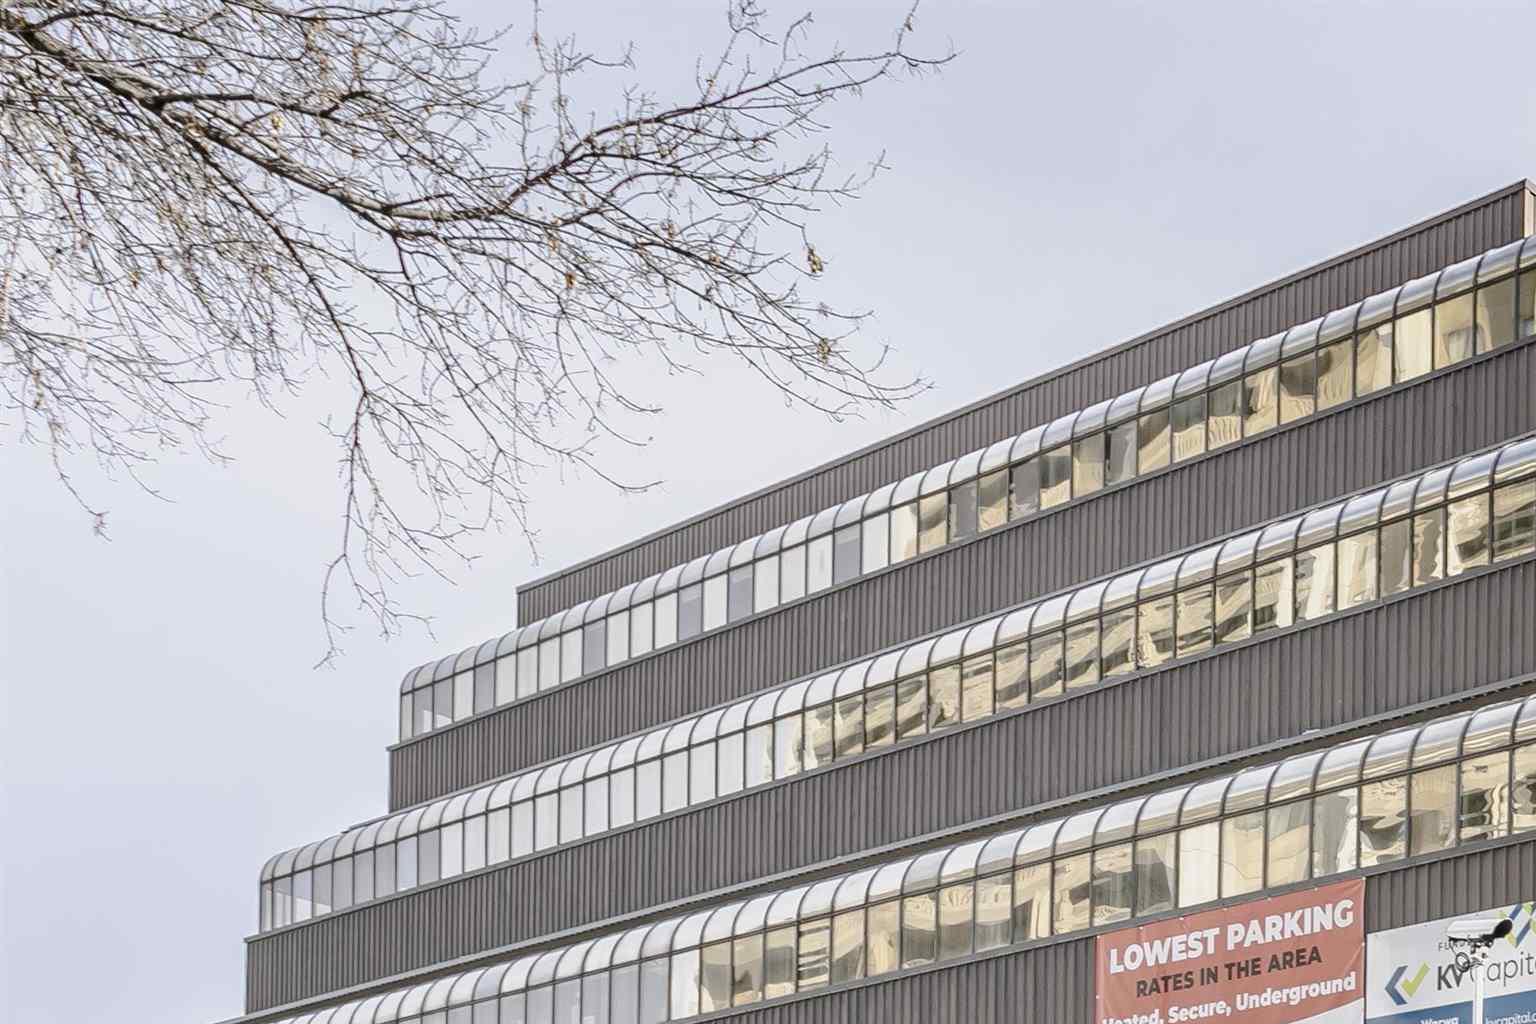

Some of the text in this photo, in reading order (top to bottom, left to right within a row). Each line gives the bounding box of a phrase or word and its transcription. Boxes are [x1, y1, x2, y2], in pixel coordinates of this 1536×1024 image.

[1109, 899, 1354, 974] LOWEST PARKING
[1136, 946, 1322, 998] RATES IN THE AREA
[1167, 998, 1231, 1024] Secure,
[1236, 972, 1356, 1011] Underground
